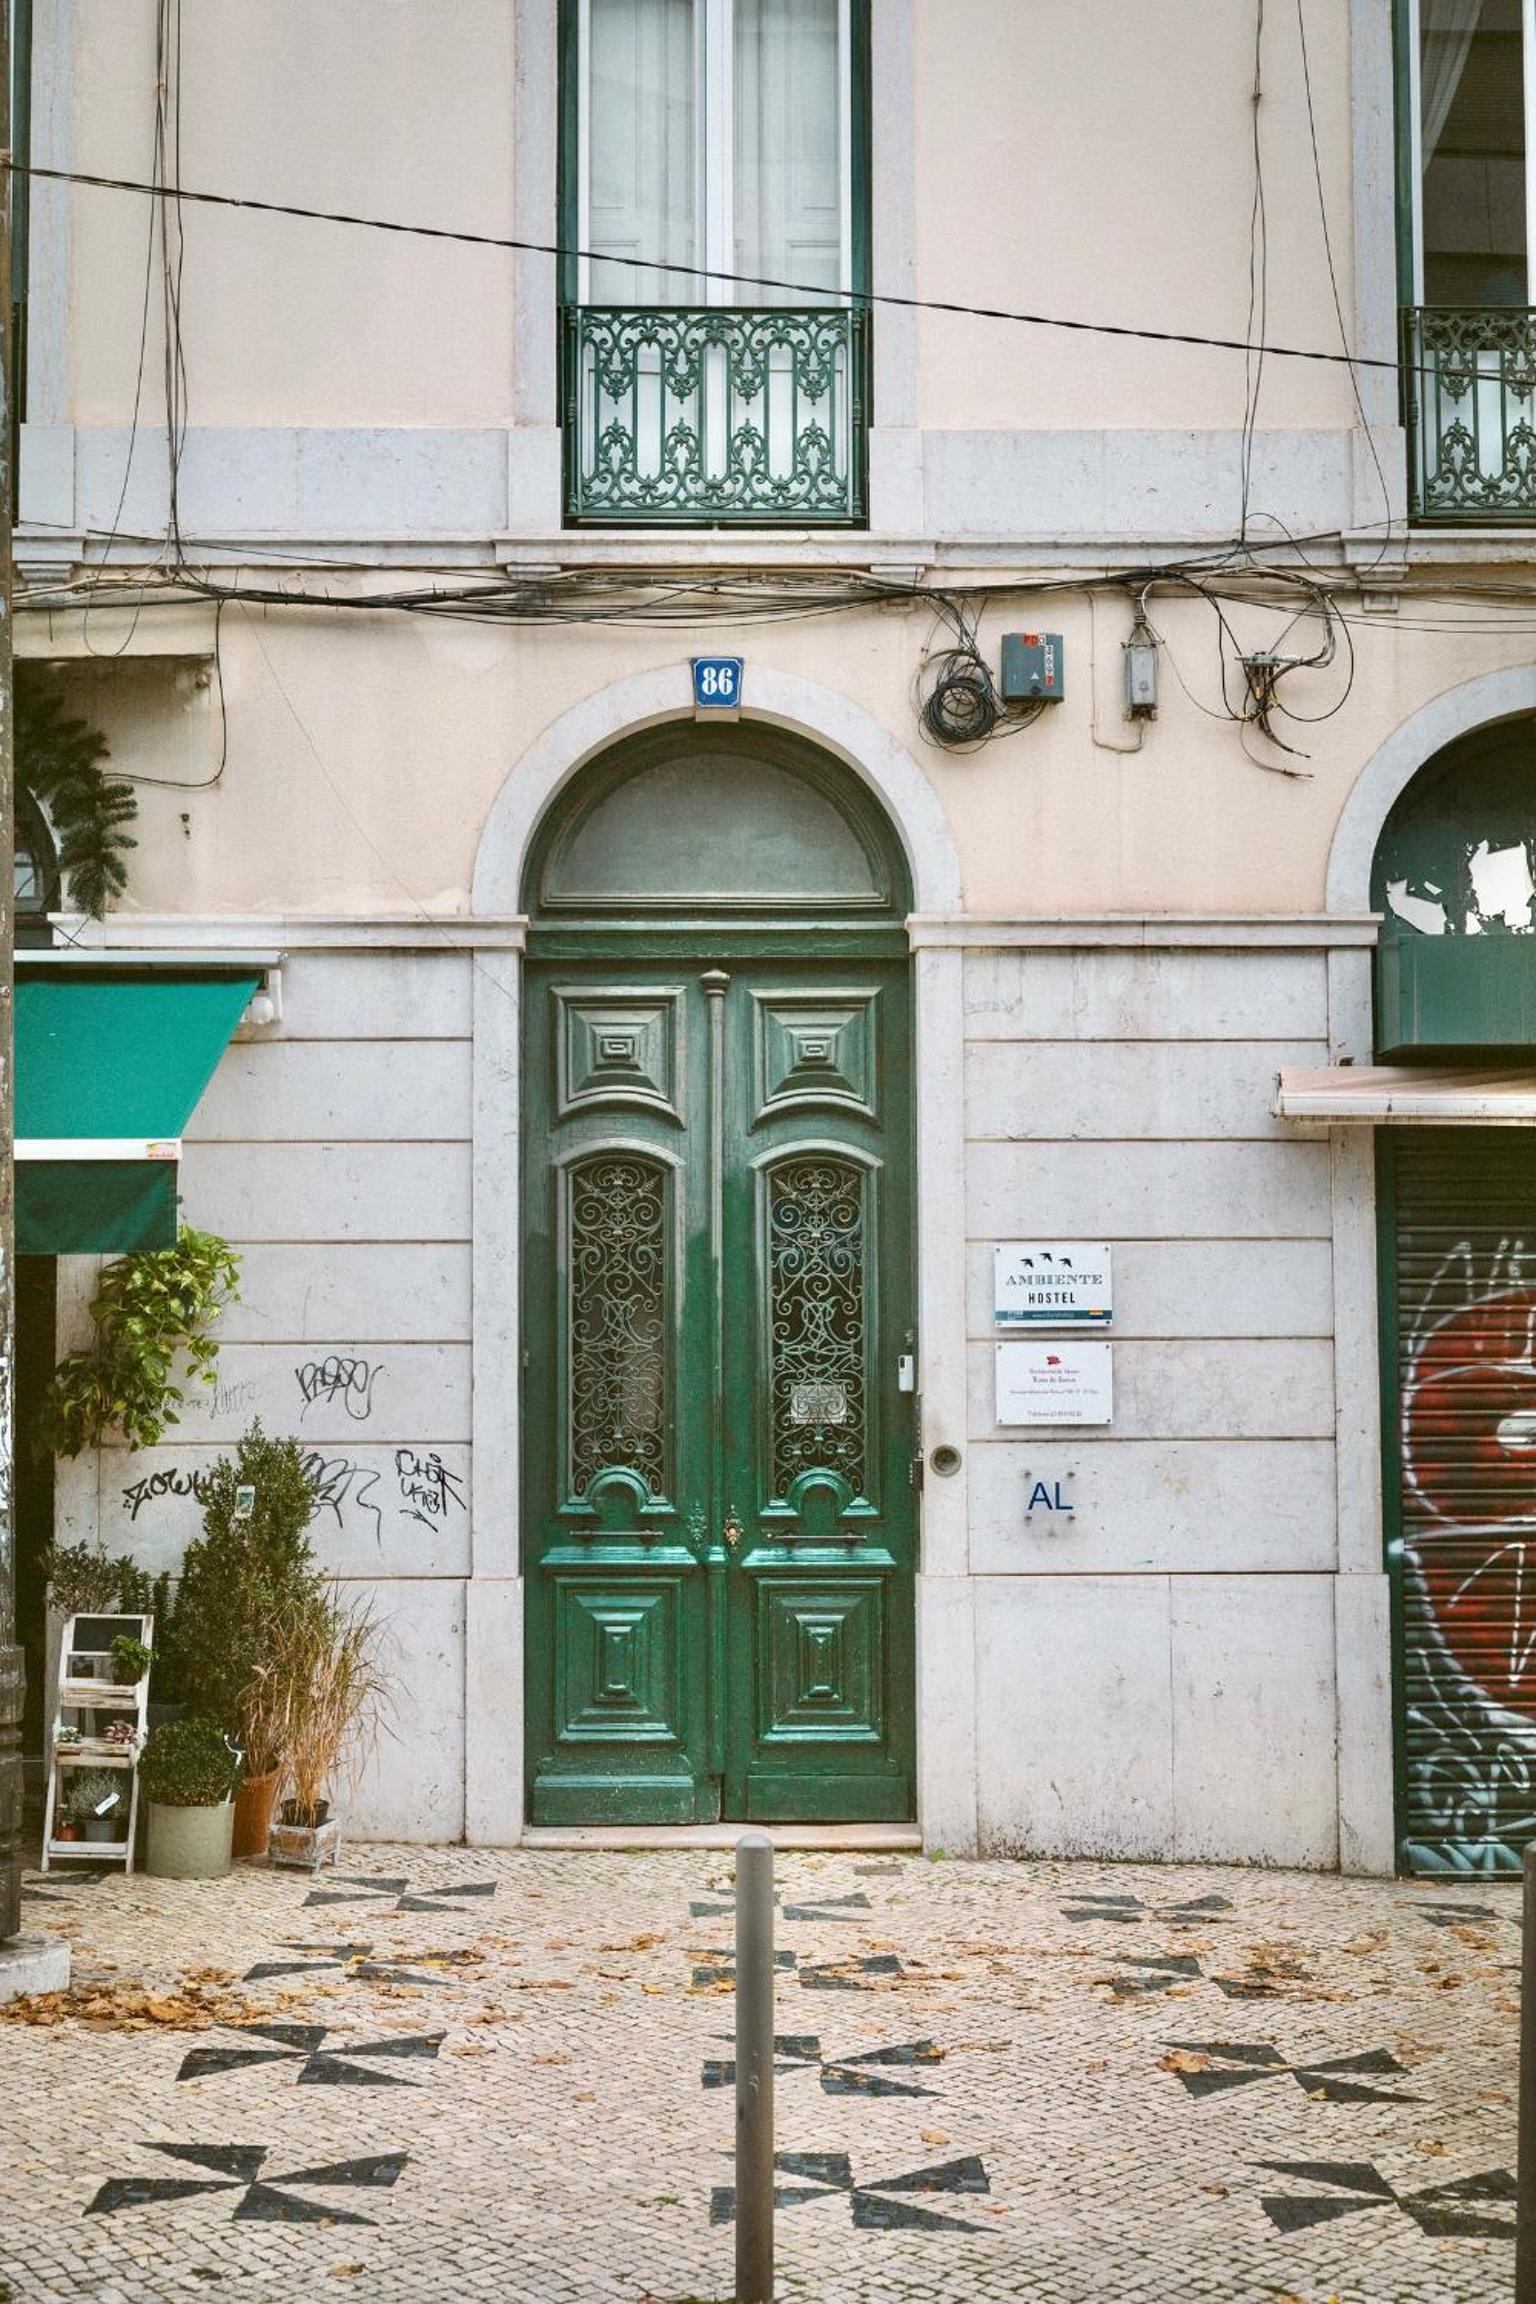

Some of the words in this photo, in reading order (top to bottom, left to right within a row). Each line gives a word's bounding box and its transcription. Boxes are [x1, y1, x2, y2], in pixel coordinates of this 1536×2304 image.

[702, 667, 734, 695] 86
[1006, 1274, 1103, 1286] AMBIENTE
[1028, 1292, 1076, 1304] HOSTEL
[1028, 1481, 1074, 1510] AL
